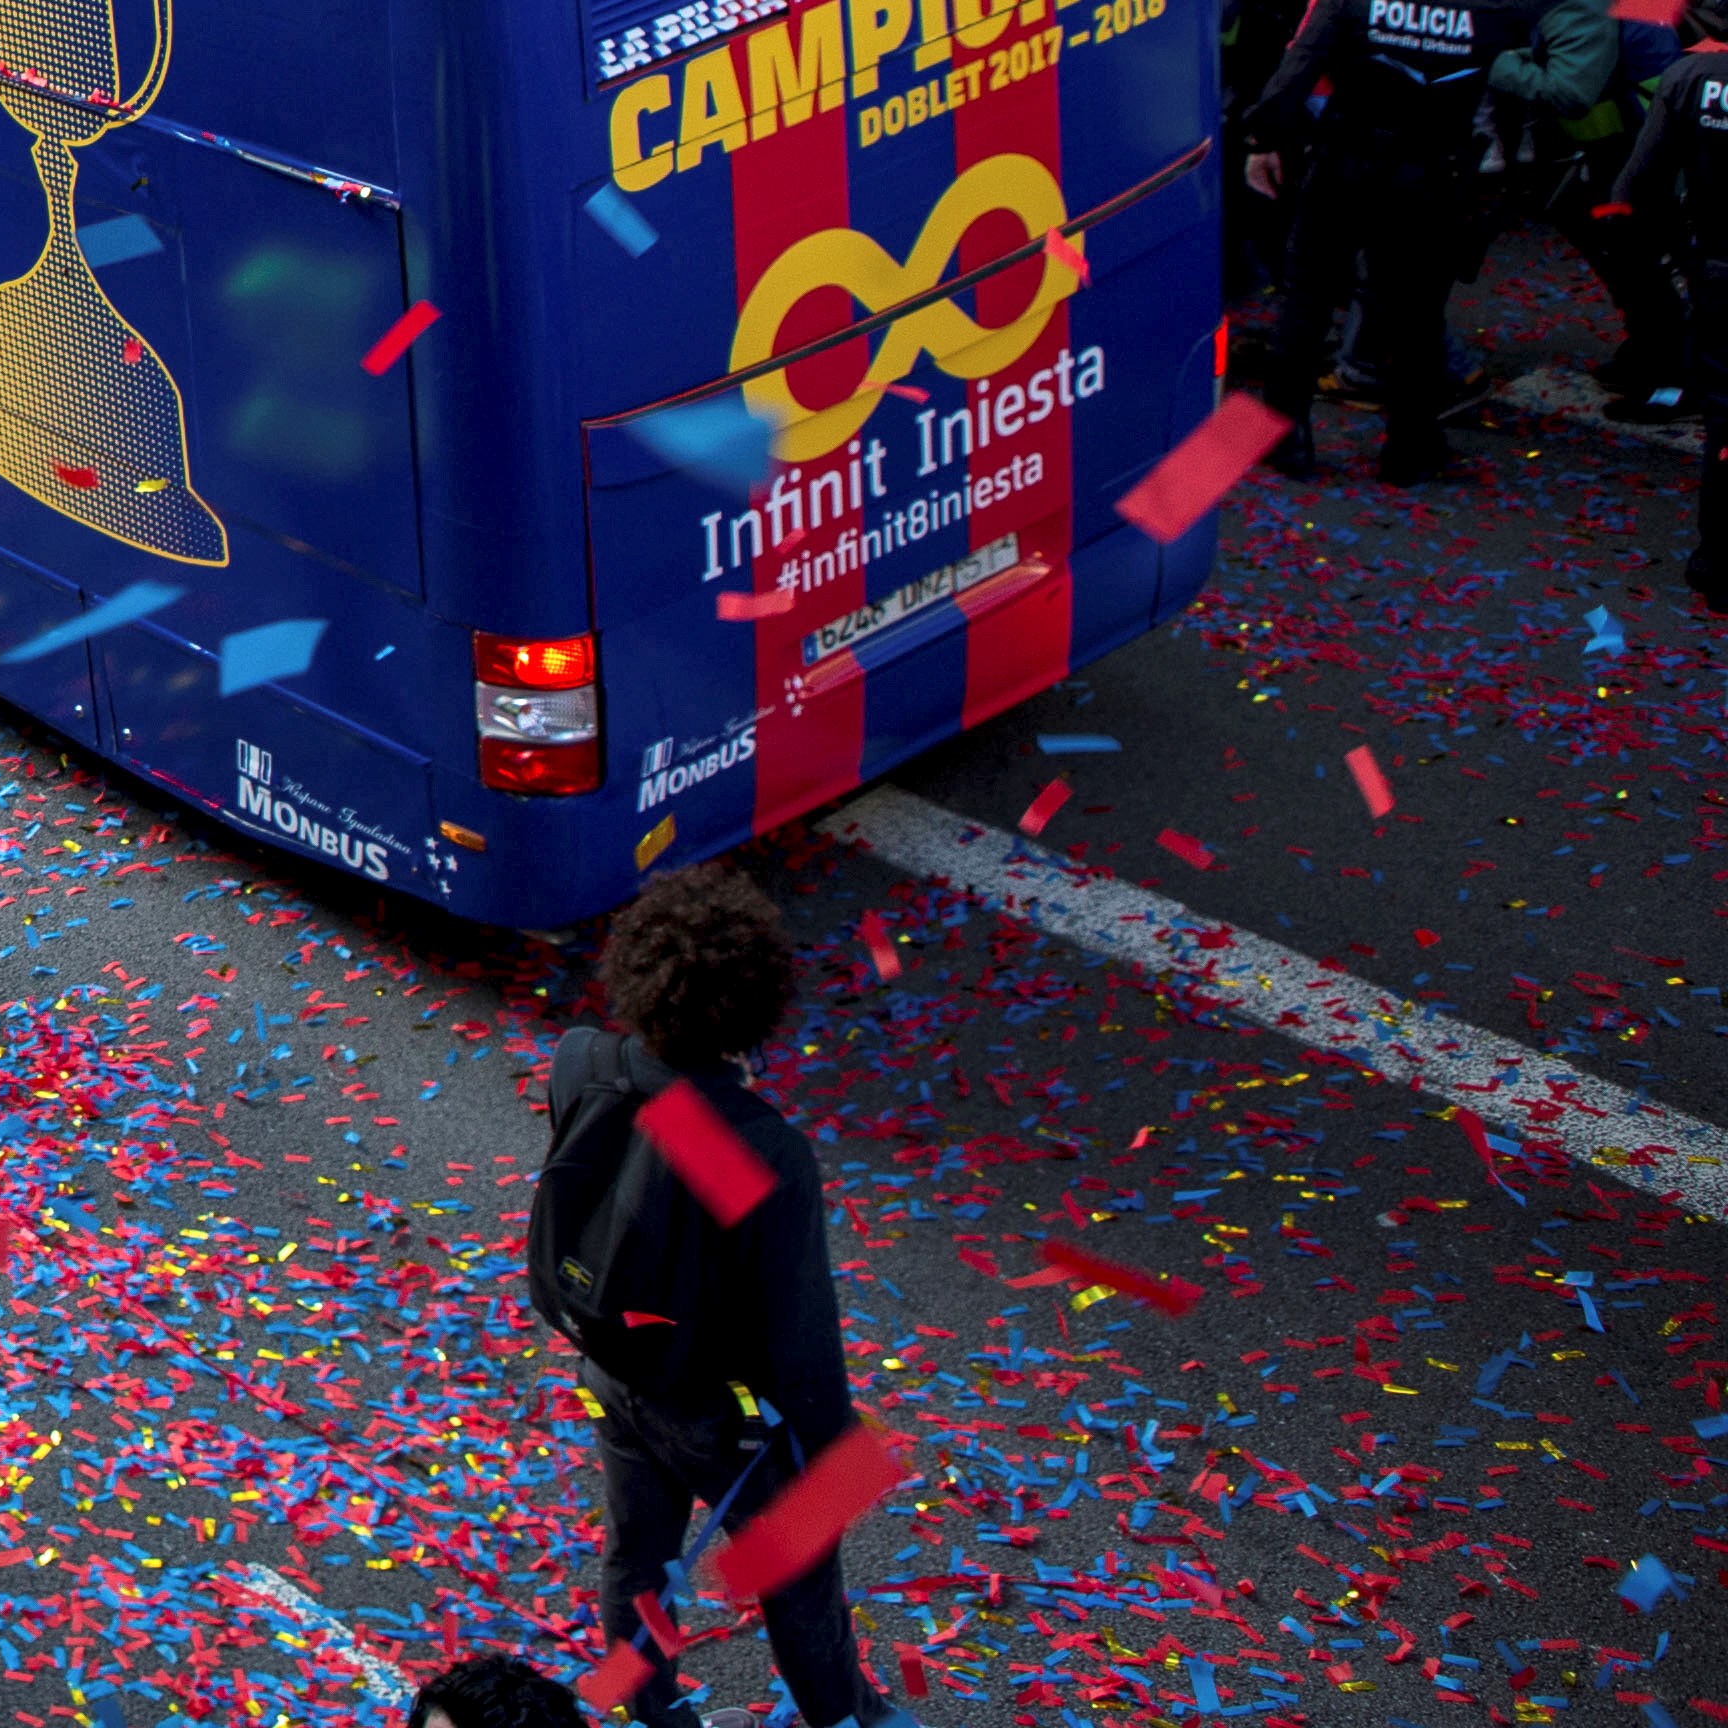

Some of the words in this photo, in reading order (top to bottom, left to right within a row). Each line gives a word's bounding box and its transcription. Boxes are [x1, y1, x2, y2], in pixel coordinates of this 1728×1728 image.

[598, 25, 653, 79] LA
[859, 61, 988, 148] DOBLET
[989, 24, 1063, 92] 2017
[700, 438, 888, 582] Infinit
[915, 344, 1106, 477] Iniesta
[775, 451, 1044, 594] #infinit8iniesta
